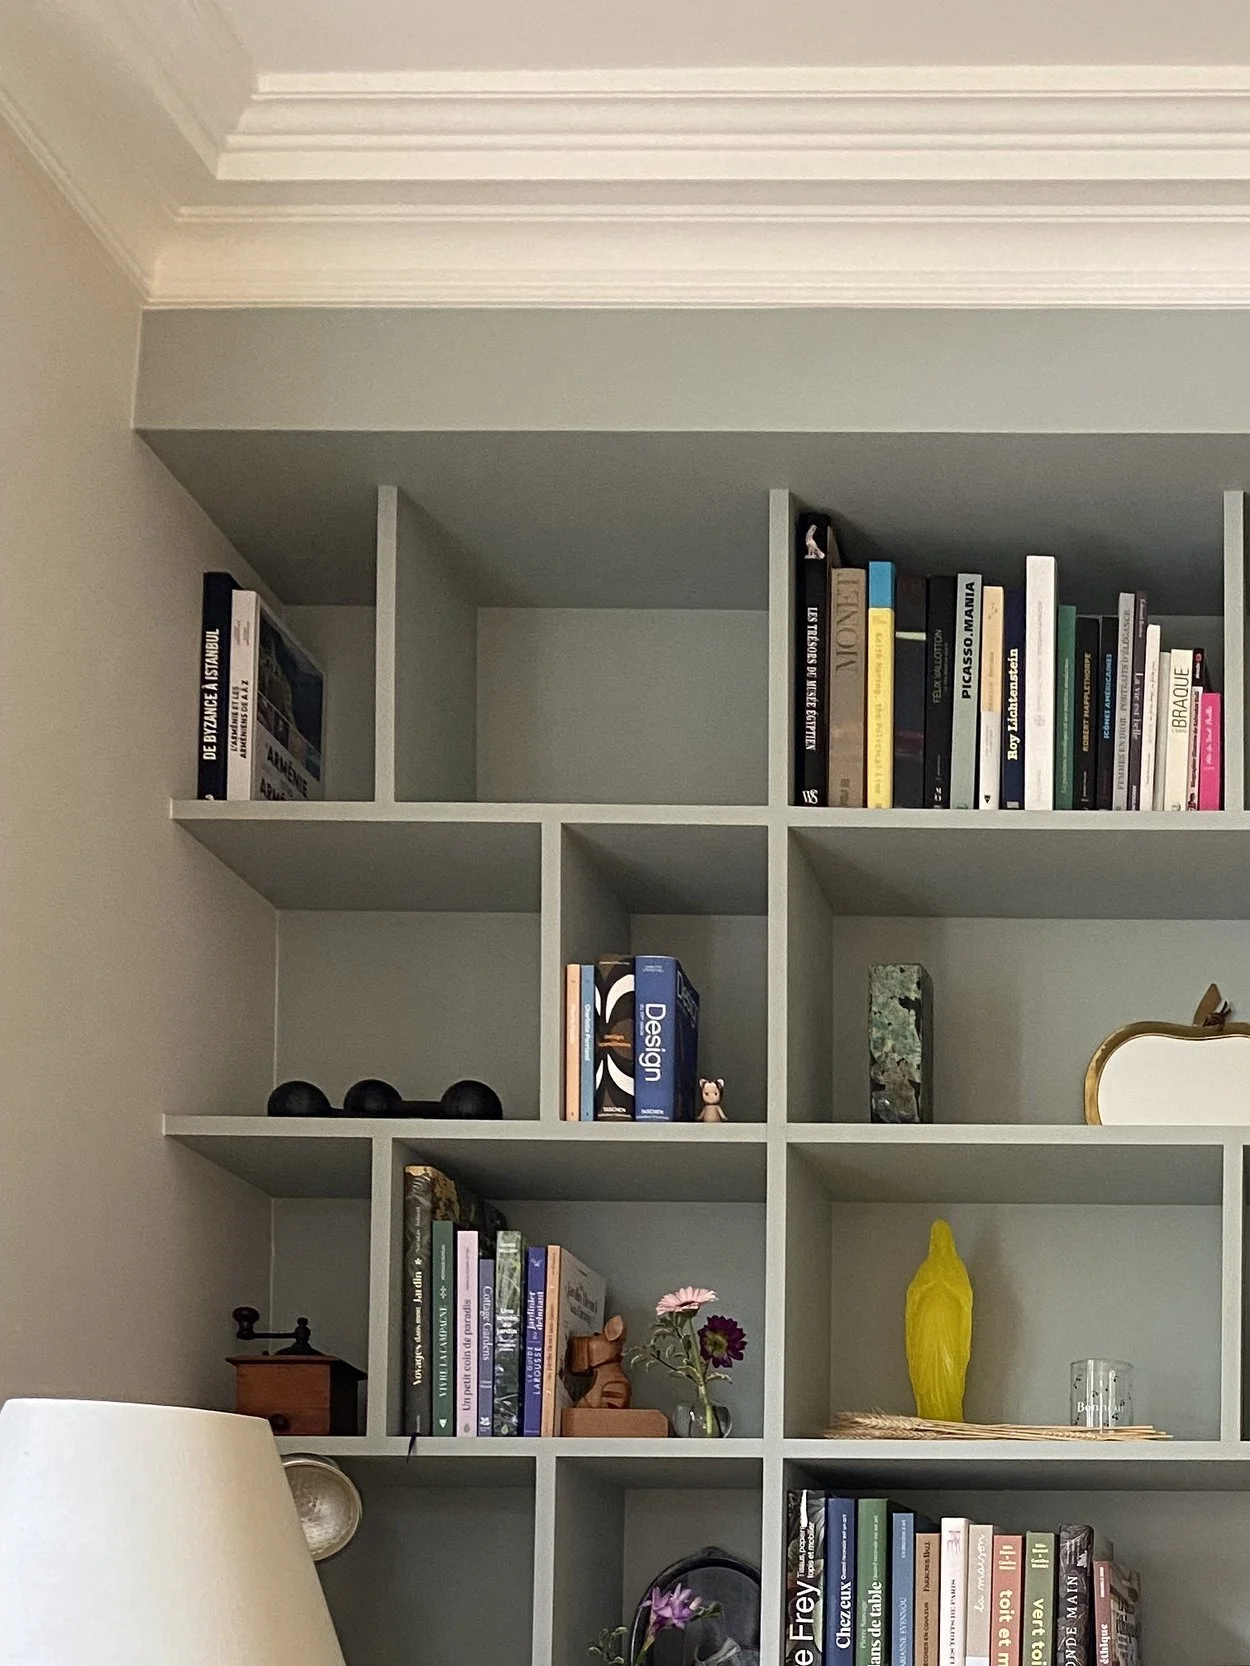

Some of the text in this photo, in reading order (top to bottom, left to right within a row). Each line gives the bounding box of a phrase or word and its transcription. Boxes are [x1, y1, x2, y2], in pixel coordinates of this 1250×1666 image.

[835, 573, 859, 674] MONET
[962, 581, 975, 700] PICASSO.MANIA
[201, 628, 220, 760] DE BYZANCE À ISTANBUL
[805, 607, 819, 750] LES TRÉSORS DU MUSÉE ÉGYPTIEN
[1007, 648, 1021, 761] Roy Lichtenstein
[1133, 687, 1142, 702] vie
[1134, 673, 1143, 684] La
[1171, 668, 1189, 728] BRAQUE
[1082, 719, 1090, 752] ROBERT
[639, 1003, 666, 1081] Design
[412, 1271, 422, 1304] Jardin
[480, 1285, 493, 1361] Cottage Gardens
[412, 1345, 425, 1386] Voyages
[438, 1305, 448, 1398] VIVRE LA CAMPAGNE
[462, 1299, 474, 1412] Un petit coin de paradis
[534, 1346, 542, 1395] LAROUSSE
[797, 1553, 807, 1578] Tissus,
[806, 1521, 816, 1578] tapis et mobilier
[975, 1533, 986, 1596] maison
[789, 1580, 821, 1641] Frey
[836, 1581, 852, 1649] Chez eux
[867, 1582, 882, 1617] table
[999, 1589, 1015, 1623] toit
[1032, 1598, 1045, 1636] vert
[1067, 1575, 1078, 1619] MAIN
[867, 1620, 881, 1637] de
[998, 1629, 1012, 1647] et
[1100, 1623, 1112, 1665] éthique
